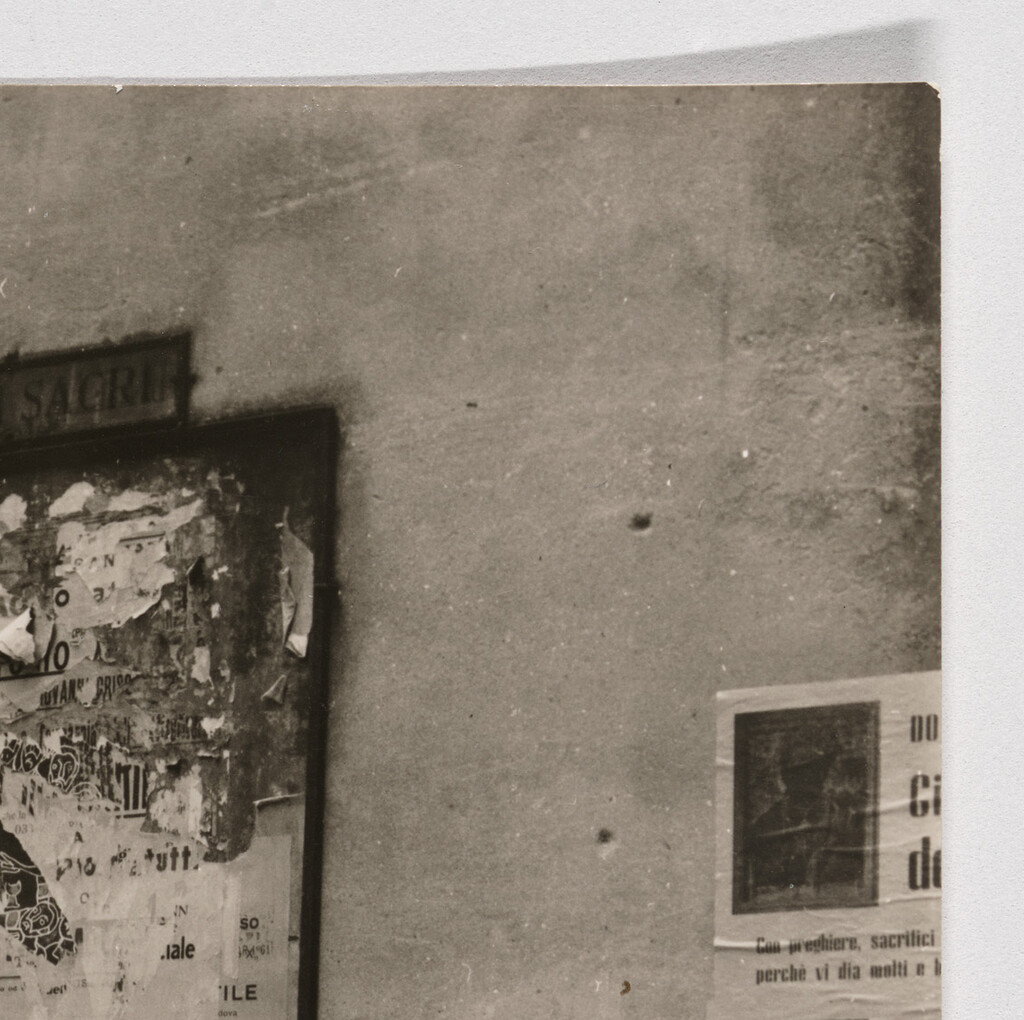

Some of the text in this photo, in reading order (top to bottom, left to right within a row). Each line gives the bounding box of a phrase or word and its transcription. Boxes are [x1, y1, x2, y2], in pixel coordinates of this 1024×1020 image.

[21, 361, 152, 420] SACRI
[870, 929, 935, 950] sacrifici
[756, 964, 807, 986] perchè
[815, 963, 830, 982] vi
[838, 961, 861, 982] dia
[870, 958, 908, 980] molti
[916, 962, 925, 977] e
